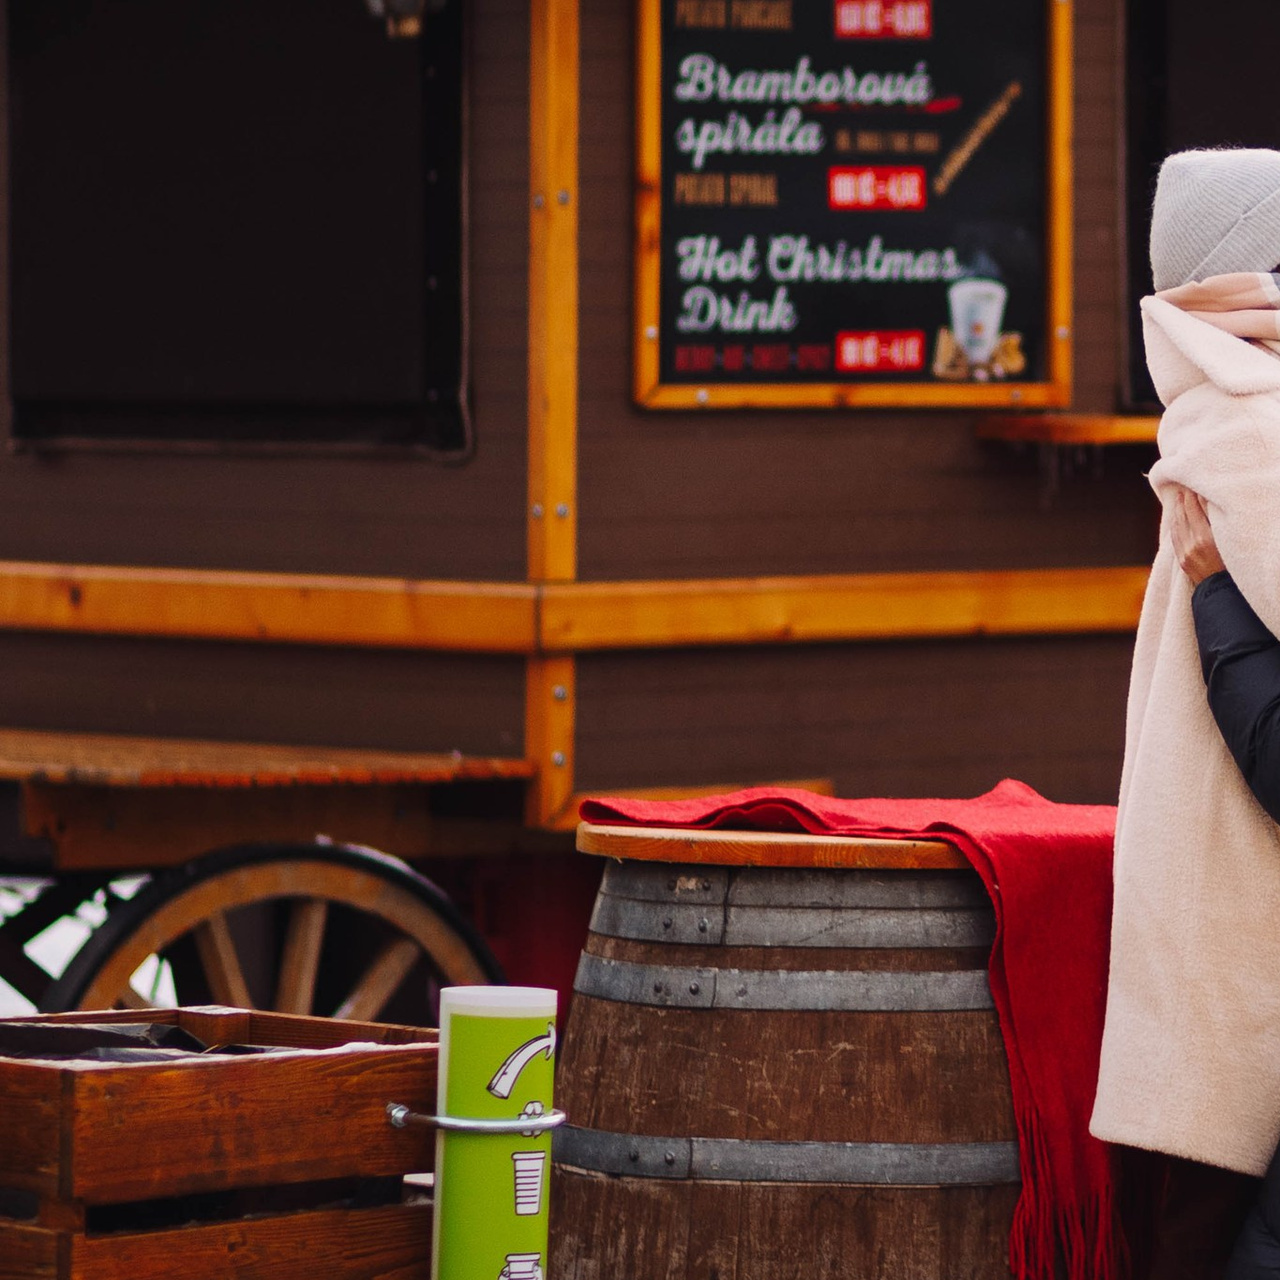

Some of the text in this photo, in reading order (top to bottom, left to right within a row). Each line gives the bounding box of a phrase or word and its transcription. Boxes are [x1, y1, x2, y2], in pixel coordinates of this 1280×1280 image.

[676, 54, 931, 105] Bramborová
[676, 109, 824, 169] spirála
[677, 236, 963, 282] Hot Christmas
[676, 286, 796, 332] Drink
